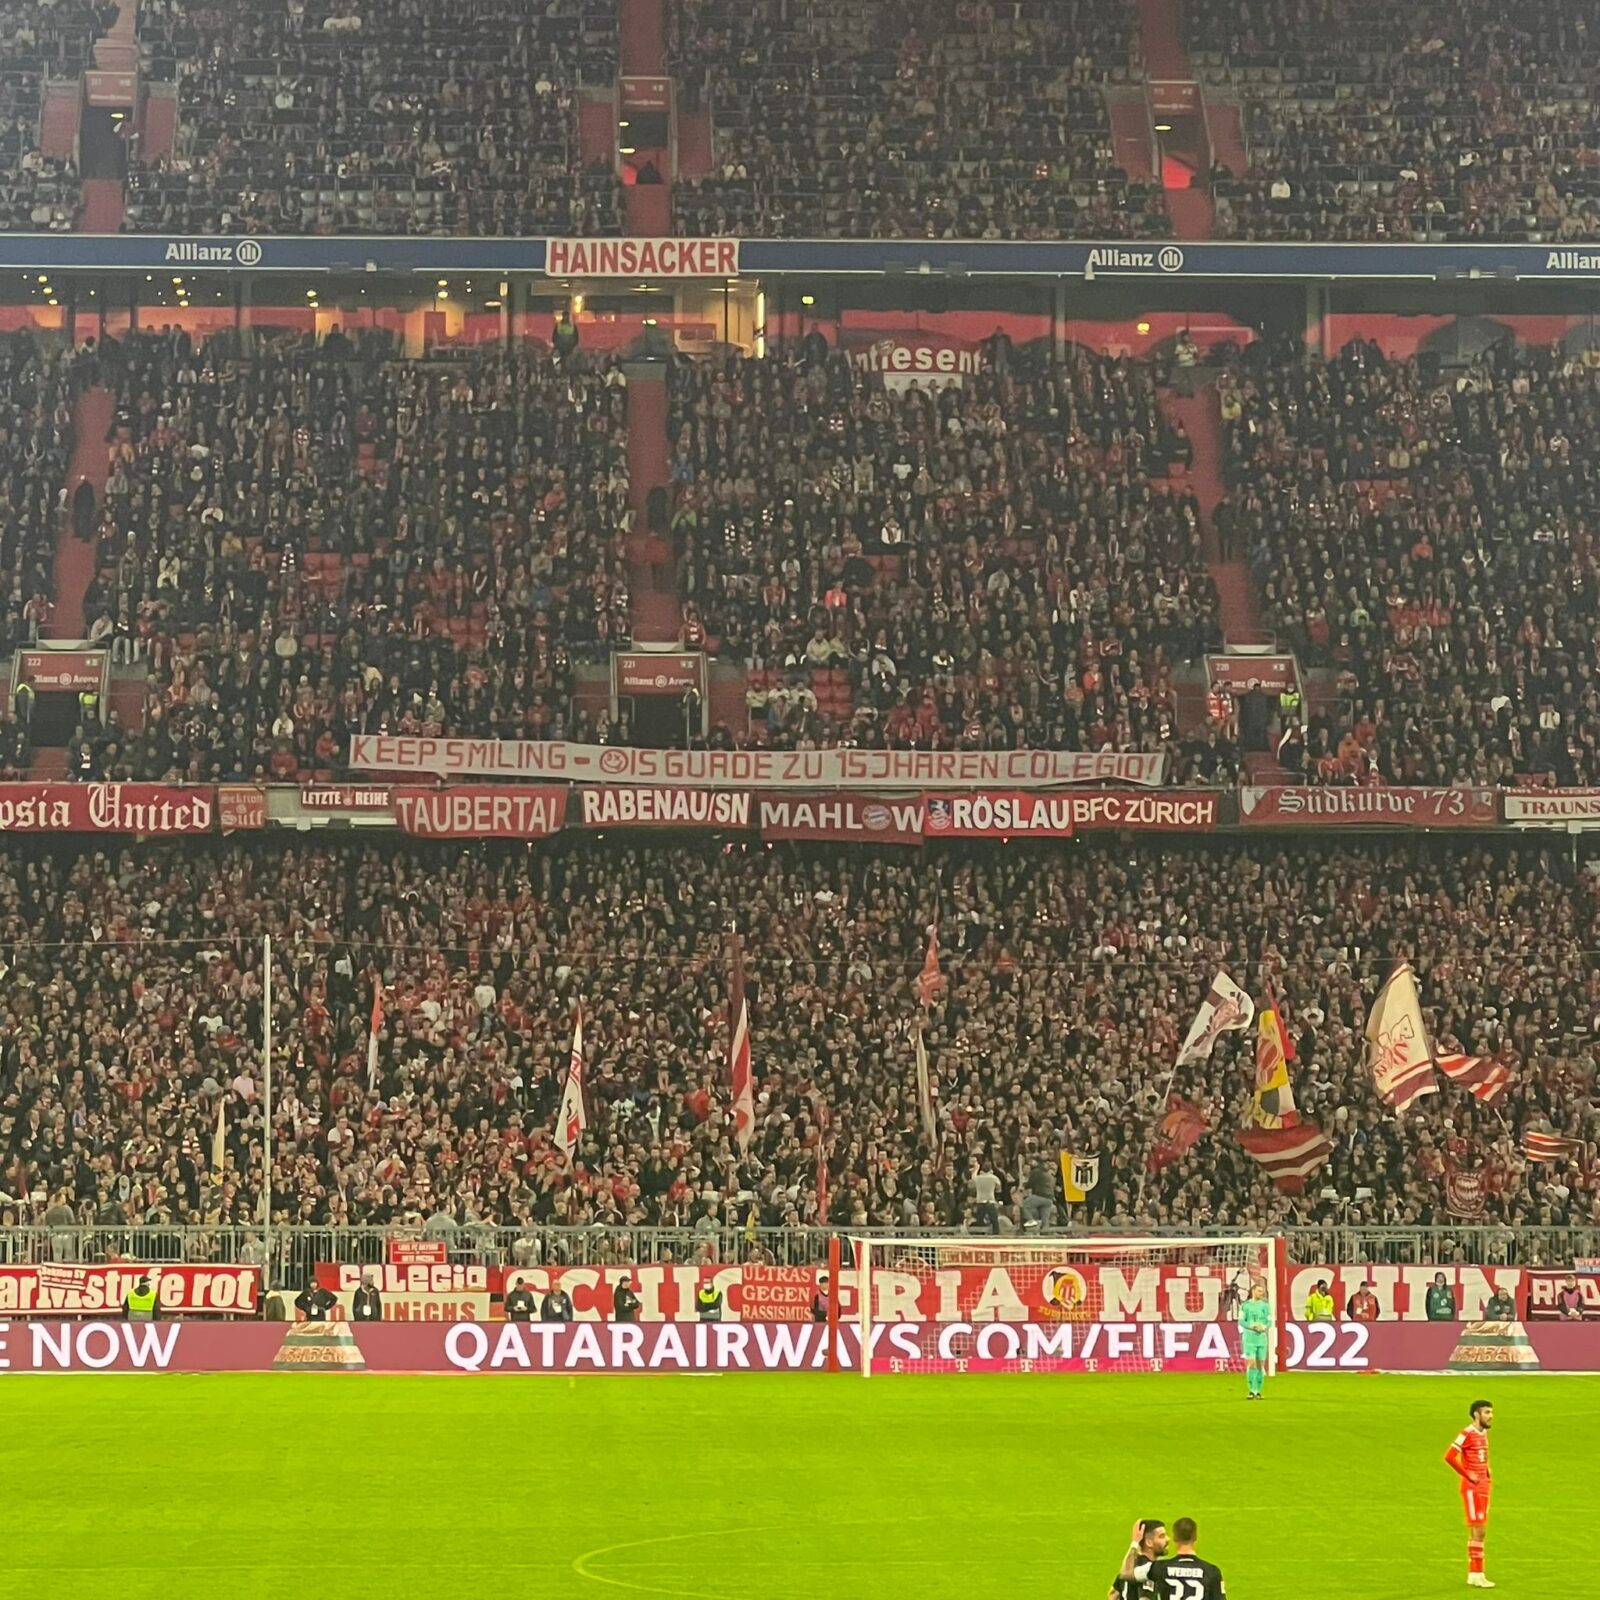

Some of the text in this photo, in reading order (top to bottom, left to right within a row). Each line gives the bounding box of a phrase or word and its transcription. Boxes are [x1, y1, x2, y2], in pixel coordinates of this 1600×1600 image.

[165, 243, 233, 260] Allianz
[550, 241, 737, 273] HAINSACKER
[1088, 249, 1154, 266] Allianz
[1546, 252, 1600, 269] Allian
[353, 736, 437, 765] KEEP
[446, 741, 566, 770] SMILING
[782, 753, 823, 780] ZU
[1007, 752, 1158, 780] COLEGIO!
[87, 783, 211, 832] United
[302, 790, 389, 806] LETZTE REIHE
[583, 789, 750, 825] RABENAU/SN
[953, 796, 1070, 829] RÖSLAU
[1073, 797, 1213, 825] BFC ZÜRICH
[1278, 788, 1416, 814] Südkurve
[396, 796, 561, 833] TAUBERTAL
[192, 1270, 255, 1309] rot
[743, 1266, 811, 1283] ULTRAS
[506, 1267, 1029, 1322] SCHICERIA
[742, 1284, 811, 1302] GEGEN
[742, 1304, 812, 1321] RASSISMUS
[28, 1323, 182, 1368] NOW
